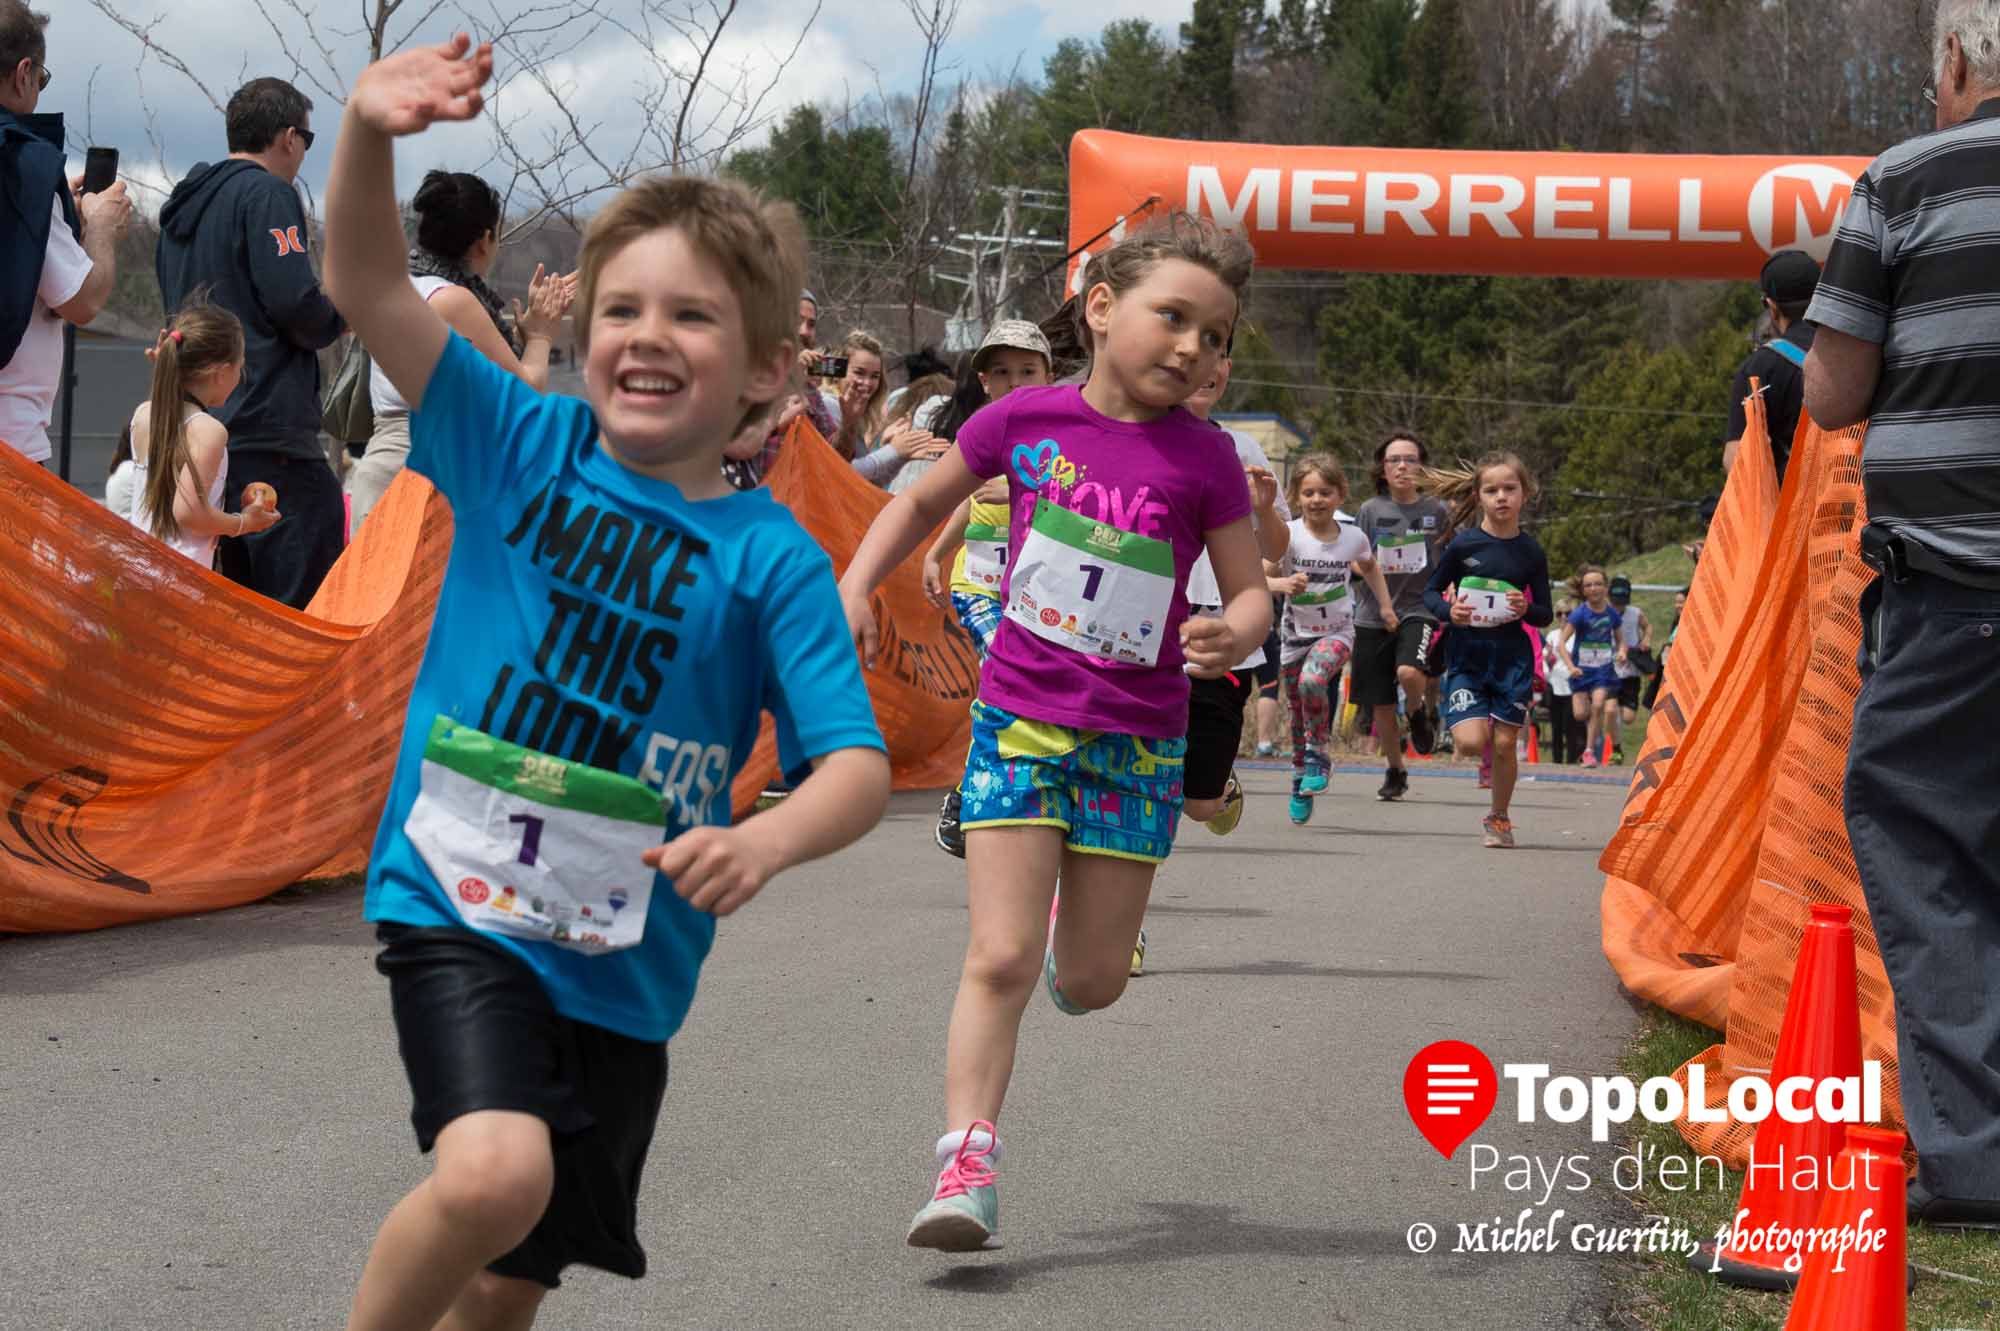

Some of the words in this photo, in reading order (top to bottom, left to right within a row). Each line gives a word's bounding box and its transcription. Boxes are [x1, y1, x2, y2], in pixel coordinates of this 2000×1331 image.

[1186, 164, 1741, 244] MERRELL
[532, 495, 710, 622] MAKE
[1080, 564, 1104, 602] 1
[1485, 595, 1495, 609] 1
[534, 591, 677, 715] THIS
[640, 731, 733, 825] EAS
[509, 813, 545, 866] 1
